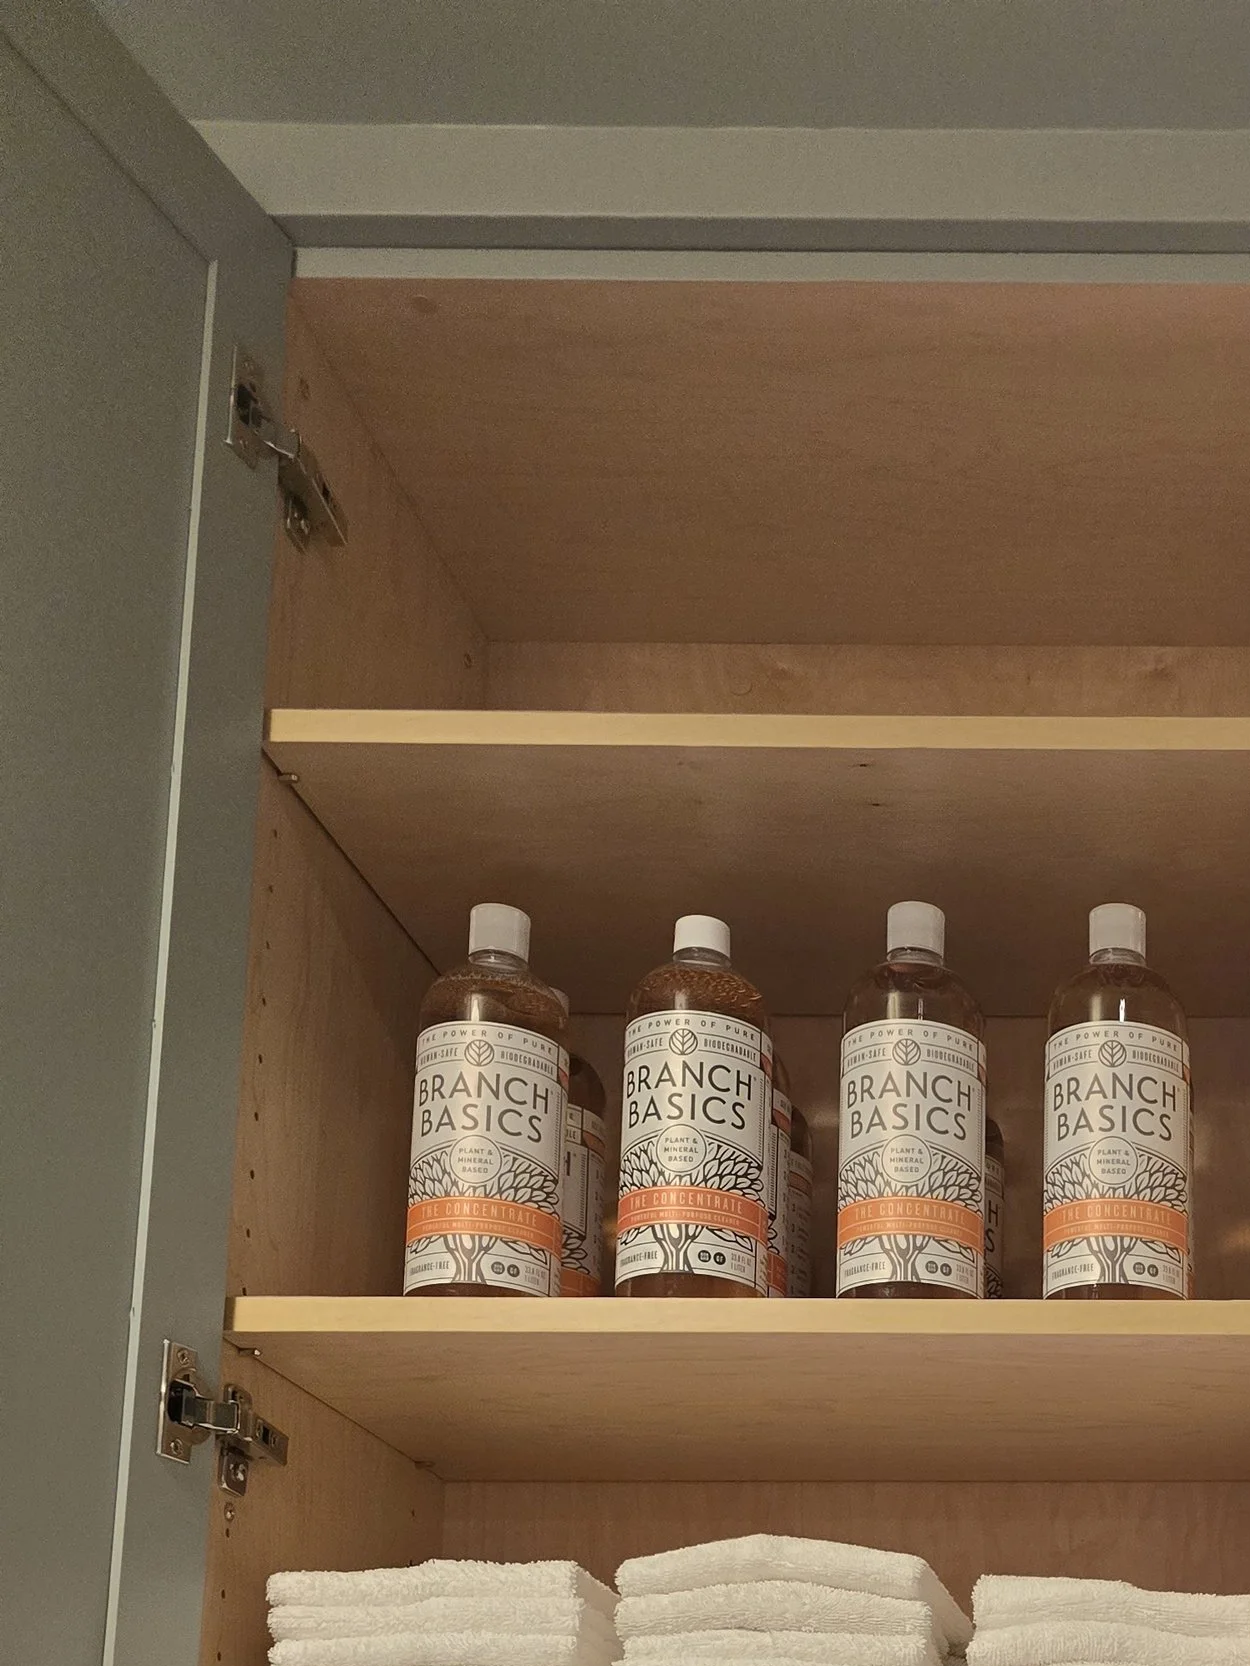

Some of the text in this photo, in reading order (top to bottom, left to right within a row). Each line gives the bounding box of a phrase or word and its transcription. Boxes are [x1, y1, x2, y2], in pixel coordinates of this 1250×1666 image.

[648, 1018, 691, 1028] POWER
[700, 1020, 717, 1028] OF
[726, 1025, 755, 1041] PURE
[870, 1028, 913, 1039] POWER
[923, 1030, 938, 1038] OF
[947, 1035, 973, 1051] PURE
[1076, 1030, 1119, 1041] POWER
[1129, 1031, 1143, 1040] OF
[1152, 1036, 1177, 1052] PURE
[442, 1029, 487, 1038] POWER
[497, 1032, 513, 1041] OF
[523, 1038, 552, 1054] PURE
[704, 1038, 757, 1062] BIODEGRADABLE
[500, 1051, 554, 1076] BIODEGRADABLE
[927, 1049, 975, 1072] BIODEGRADABLE
[1132, 1050, 1179, 1072] BIODEGRADABLE
[626, 1060, 752, 1101] BRANCH
[847, 1070, 971, 1112] BRANCH
[1053, 1072, 1176, 1112] BRANCH
[419, 1071, 549, 1115] BRANCH
[628, 1092, 746, 1130] BASICS
[851, 1103, 966, 1141] BASICS
[421, 1103, 542, 1143] BASICS
[1057, 1104, 1172, 1142] BASICS
[487, 1148, 493, 1156] &
[663, 1146, 699, 1154] MINERAL
[692, 1137, 699, 1145] &
[457, 1157, 494, 1165] MINERAL
[461, 1166, 489, 1174] BASED
[667, 1155, 694, 1163] BASED
[1096, 1158, 1131, 1166] MINERAL
[1101, 1167, 1127, 1175] BASED
[421, 1202, 537, 1227] THE CONCENTRATE
[630, 1191, 743, 1215] THE CONCENTRATE
[854, 1202, 966, 1225] THE CONCENTRATE
[1061, 1204, 1172, 1226] THE CONCENTRATE
